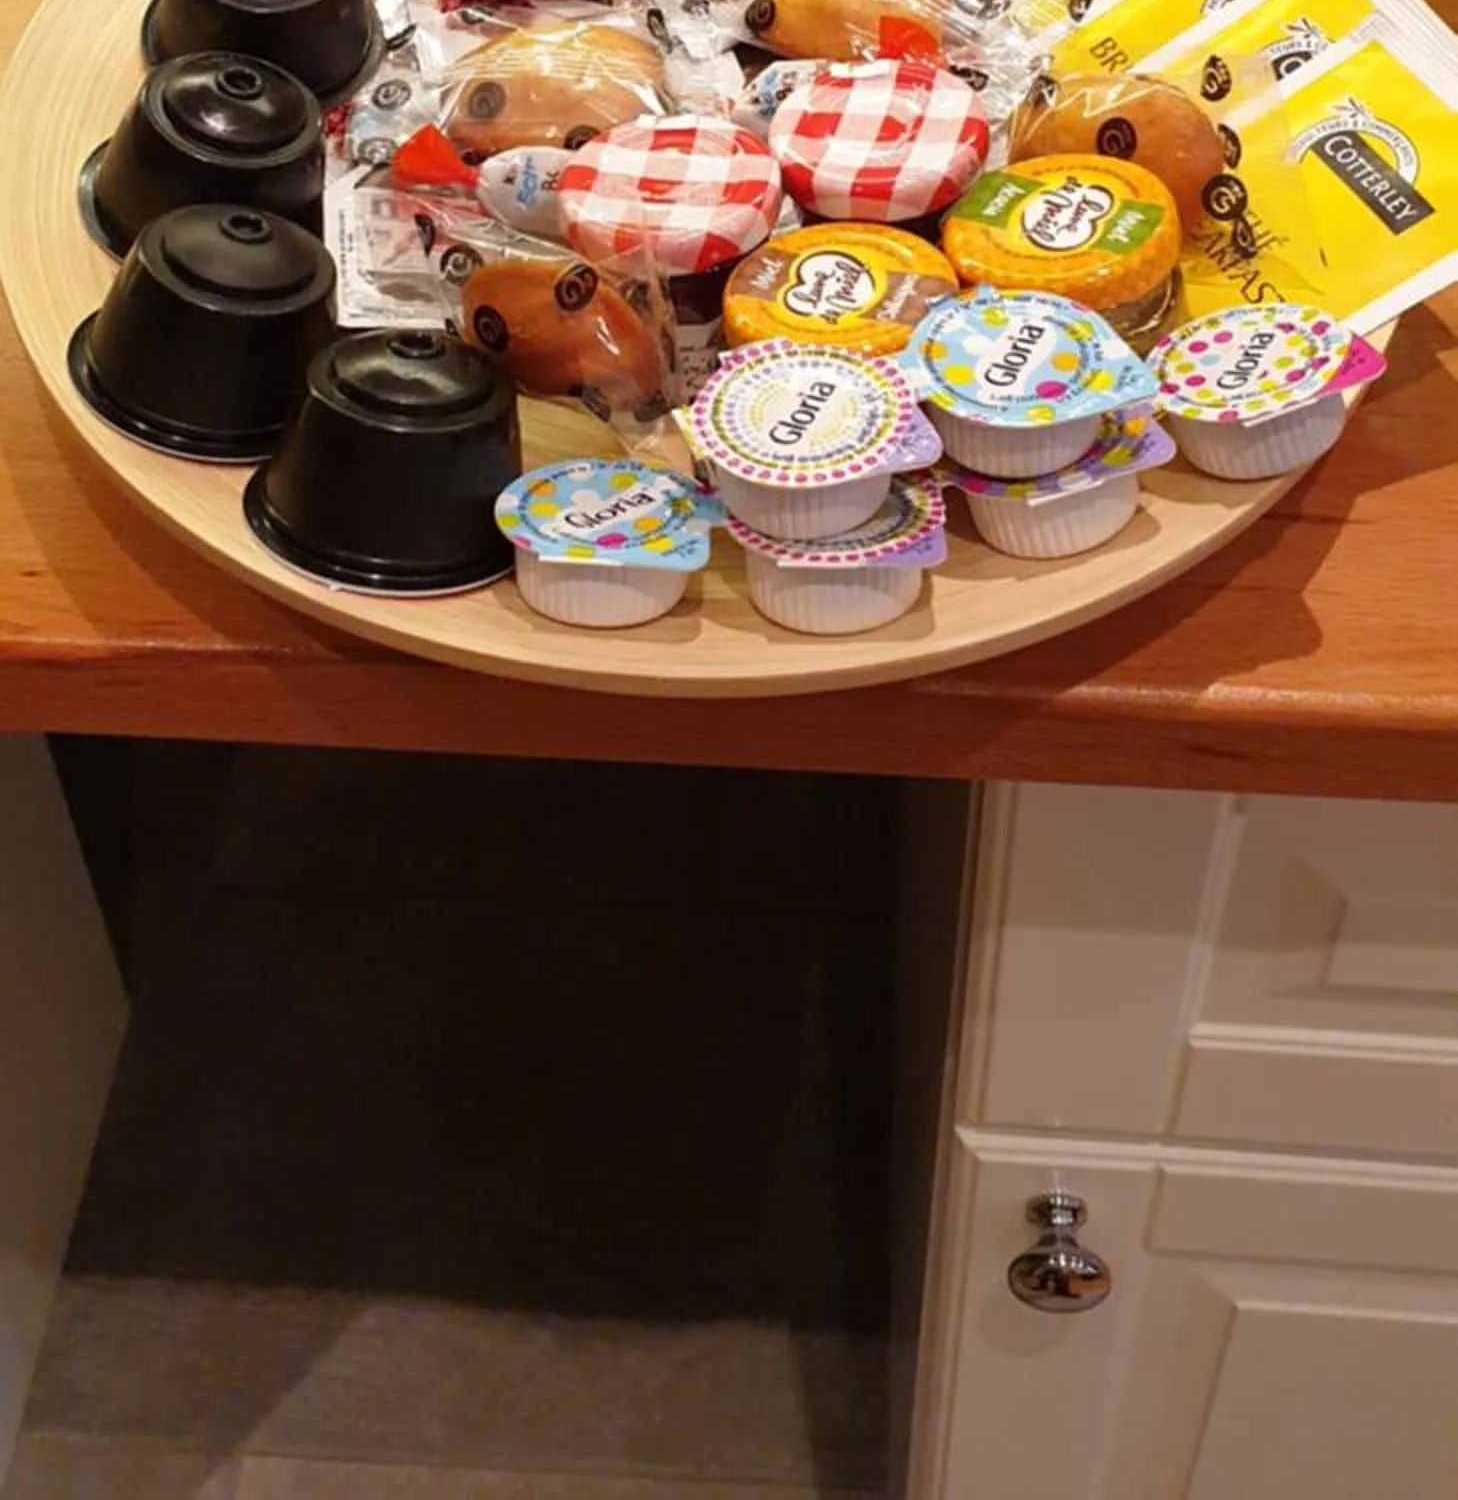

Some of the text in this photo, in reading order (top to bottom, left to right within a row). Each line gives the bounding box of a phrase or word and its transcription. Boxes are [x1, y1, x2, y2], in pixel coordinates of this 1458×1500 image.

[1323, 134, 1418, 221] COTTERLEY
[984, 321, 1047, 389] Gloria
[1216, 330, 1276, 390] Gloria
[768, 380, 837, 447] Gloria
[564, 488, 657, 530] Gloria
